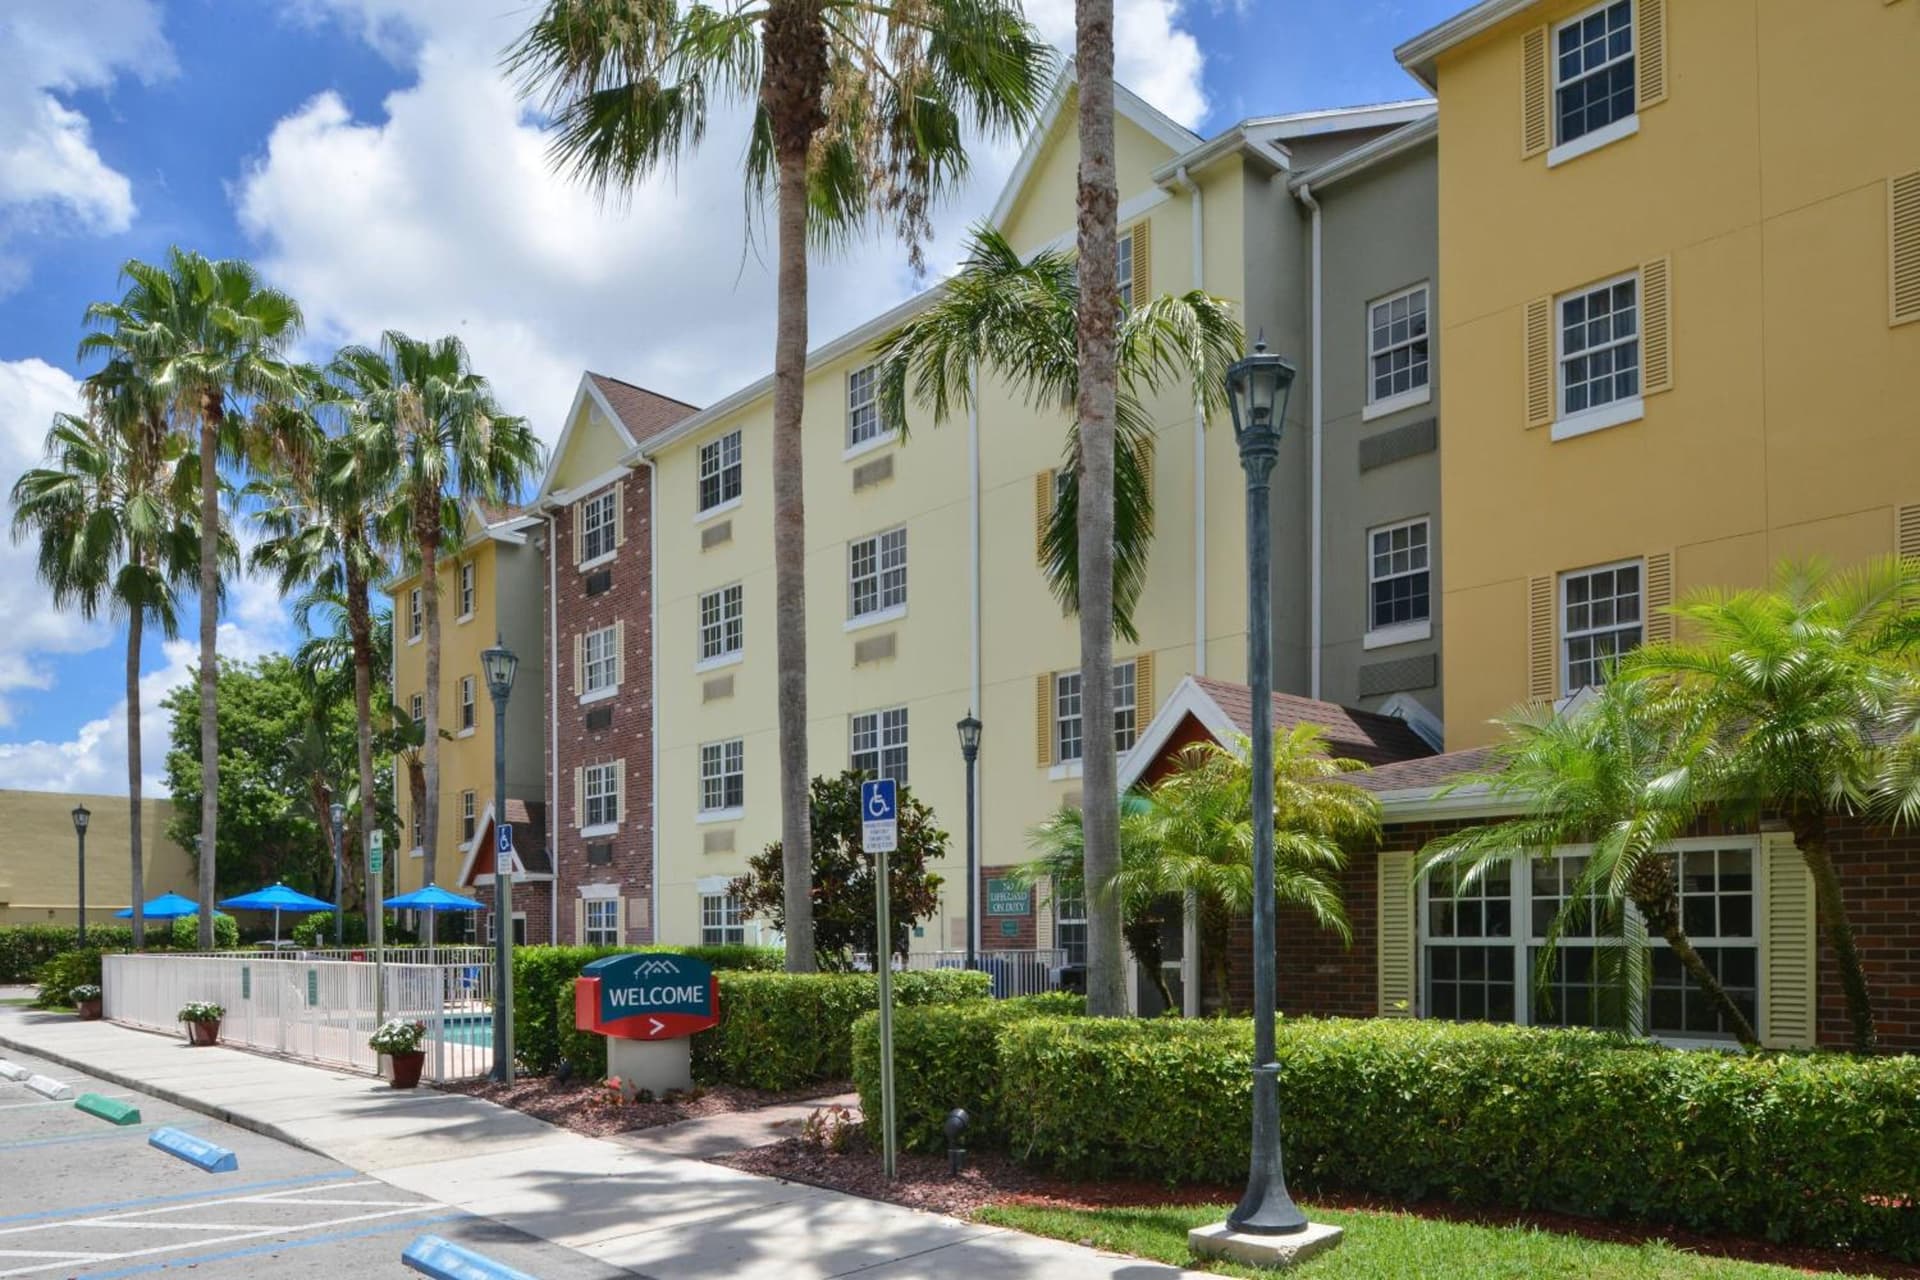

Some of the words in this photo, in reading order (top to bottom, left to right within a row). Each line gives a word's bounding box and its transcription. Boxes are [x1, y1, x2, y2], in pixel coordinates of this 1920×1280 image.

[992, 902, 1004, 912] ON
[1005, 902, 1025, 912] DUTY
[609, 985, 704, 1007] WELCOME
